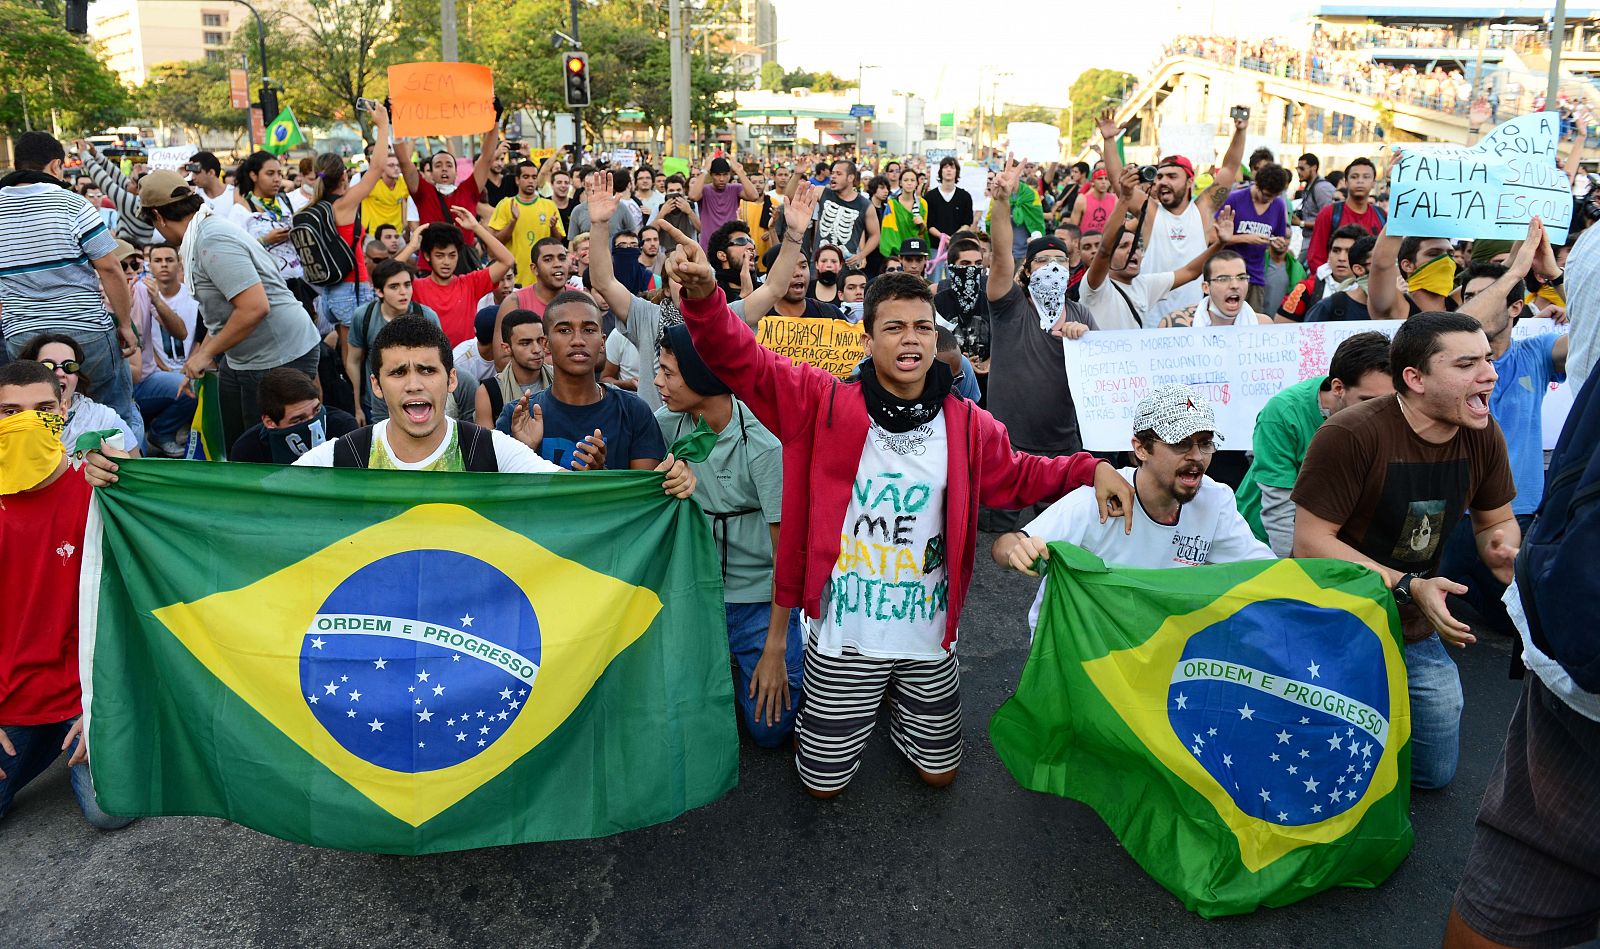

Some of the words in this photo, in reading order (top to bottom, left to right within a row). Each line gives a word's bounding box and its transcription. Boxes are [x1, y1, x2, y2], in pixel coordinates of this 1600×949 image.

[403, 72, 456, 98] SEM
[1494, 136, 1555, 157] ROLA
[1397, 154, 1488, 184] FALTA
[1394, 188, 1486, 220] FALTA
[1496, 192, 1570, 223] ESCOLA
[527, 230, 535, 247] 9
[834, 330, 854, 348] NÃO
[1079, 339, 1132, 357] PESSOAS
[1140, 334, 1194, 351] MORRENDO
[1202, 334, 1227, 349] NAS
[1237, 331, 1279, 348] FILAS
[1081, 360, 1138, 377] HOSPITAIS
[1150, 354, 1210, 371] ENQUANTO
[1238, 350, 1297, 366] DINHEIRO
[1094, 376, 1148, 394] DESVIADO
[1181, 371, 1227, 385] ENFEITAR
[1251, 367, 1285, 382] CIRCO
[1083, 395, 1106, 409] ONDE
[1241, 381, 1283, 397] CORREM
[853, 472, 931, 513] NÃO
[853, 513, 917, 545] ME
[317, 617, 392, 633] ORDEM
[402, 624, 412, 635] E
[423, 625, 535, 680] PROGRESSO
[1183, 661, 1254, 685] ORDEM
[1260, 675, 1275, 690] E
[1283, 682, 1383, 736] PROGRESSO
